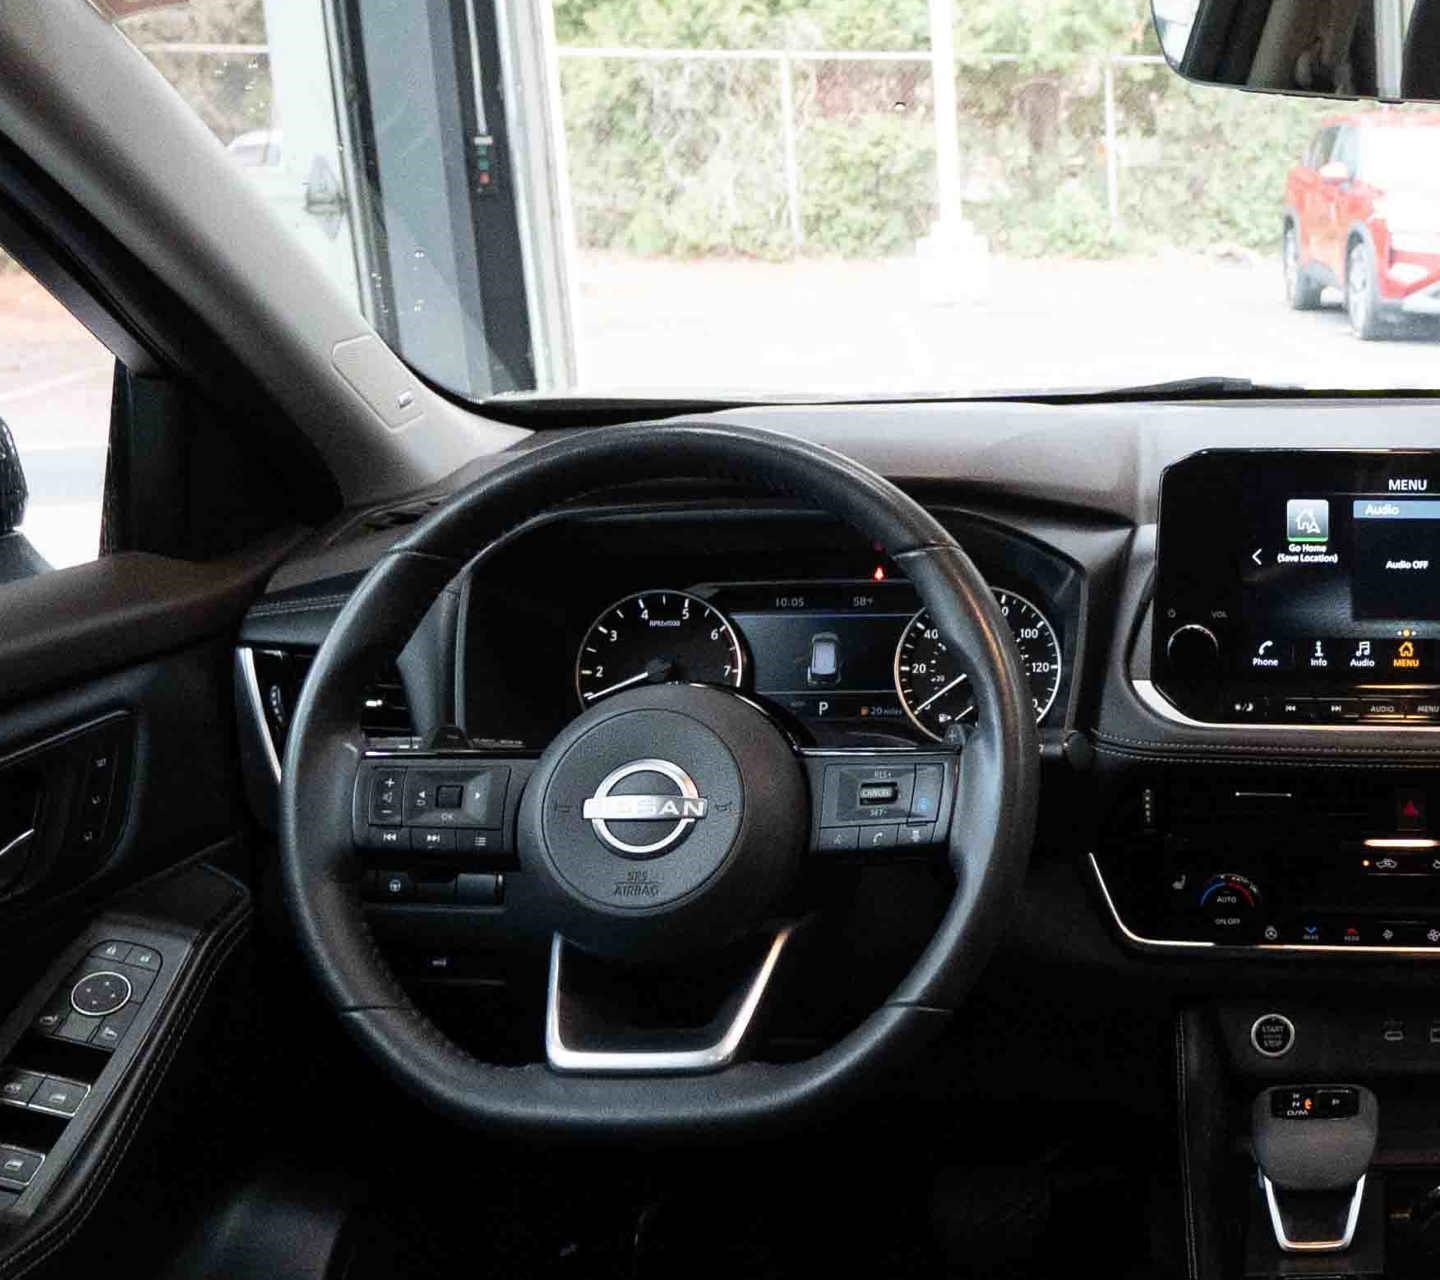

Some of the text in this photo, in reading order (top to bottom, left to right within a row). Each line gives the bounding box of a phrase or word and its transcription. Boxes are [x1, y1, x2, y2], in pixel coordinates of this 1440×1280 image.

[1388, 479, 1427, 491] MENU
[1365, 504, 1399, 516] Audio
[1288, 544, 1327, 553] Go Home
[1277, 553, 1338, 563] (Save Location)
[1386, 560, 1429, 569] Audio OFF
[641, 609, 649, 621] 4
[682, 609, 690, 620] 5
[1211, 609, 1228, 618] VOL
[610, 630, 618, 642] 3
[711, 629, 719, 641] 6
[924, 629, 939, 640] 40
[1020, 629, 1039, 639] 100
[1032, 662, 1050, 673] 120
[1253, 658, 1279, 667] Phone
[1310, 658, 1327, 667] Info
[1350, 658, 1375, 667] Audio
[1393, 659, 1419, 667] MENU
[595, 666, 604, 678] 2
[723, 665, 731, 677] 7
[912, 663, 926, 674] 20
[818, 701, 829, 716] P
[1370, 705, 1394, 713] AUDIO
[1417, 705, 1440, 713] MENU
[614, 883, 660, 897] AIRBAG
[1216, 895, 1237, 904] AUTO
